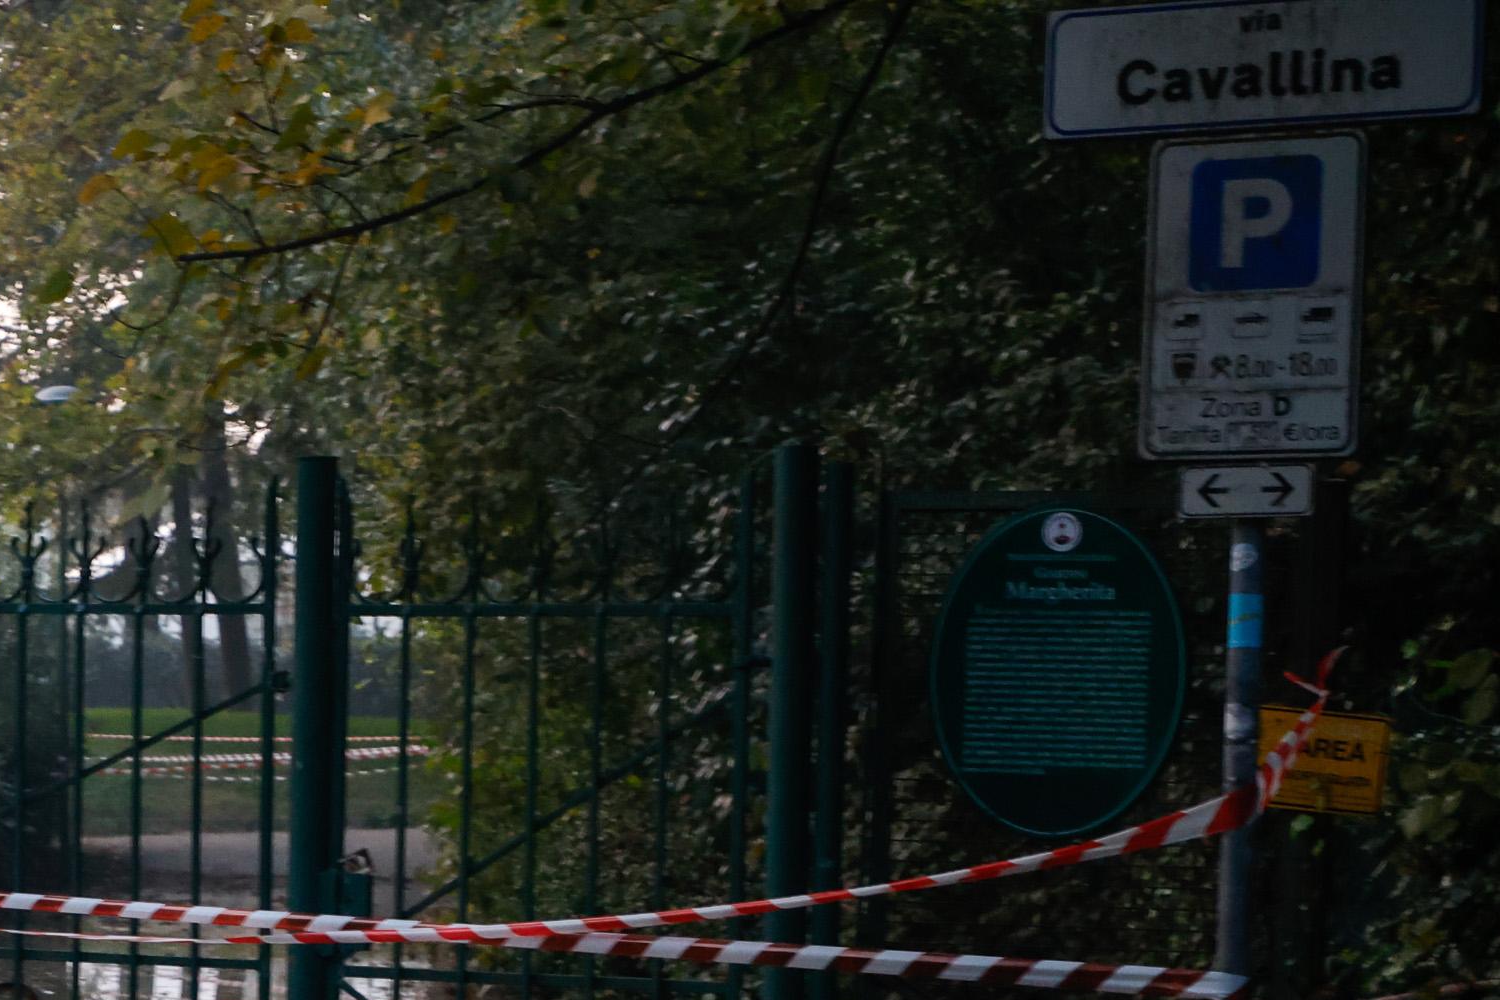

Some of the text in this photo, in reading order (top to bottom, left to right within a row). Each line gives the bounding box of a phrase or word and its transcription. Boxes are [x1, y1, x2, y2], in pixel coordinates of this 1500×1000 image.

[1240, 9, 1282, 32] via
[1117, 47, 1402, 105] Cavallina
[1219, 177, 1294, 269] P
[1199, 395, 1293, 418] Zona D
